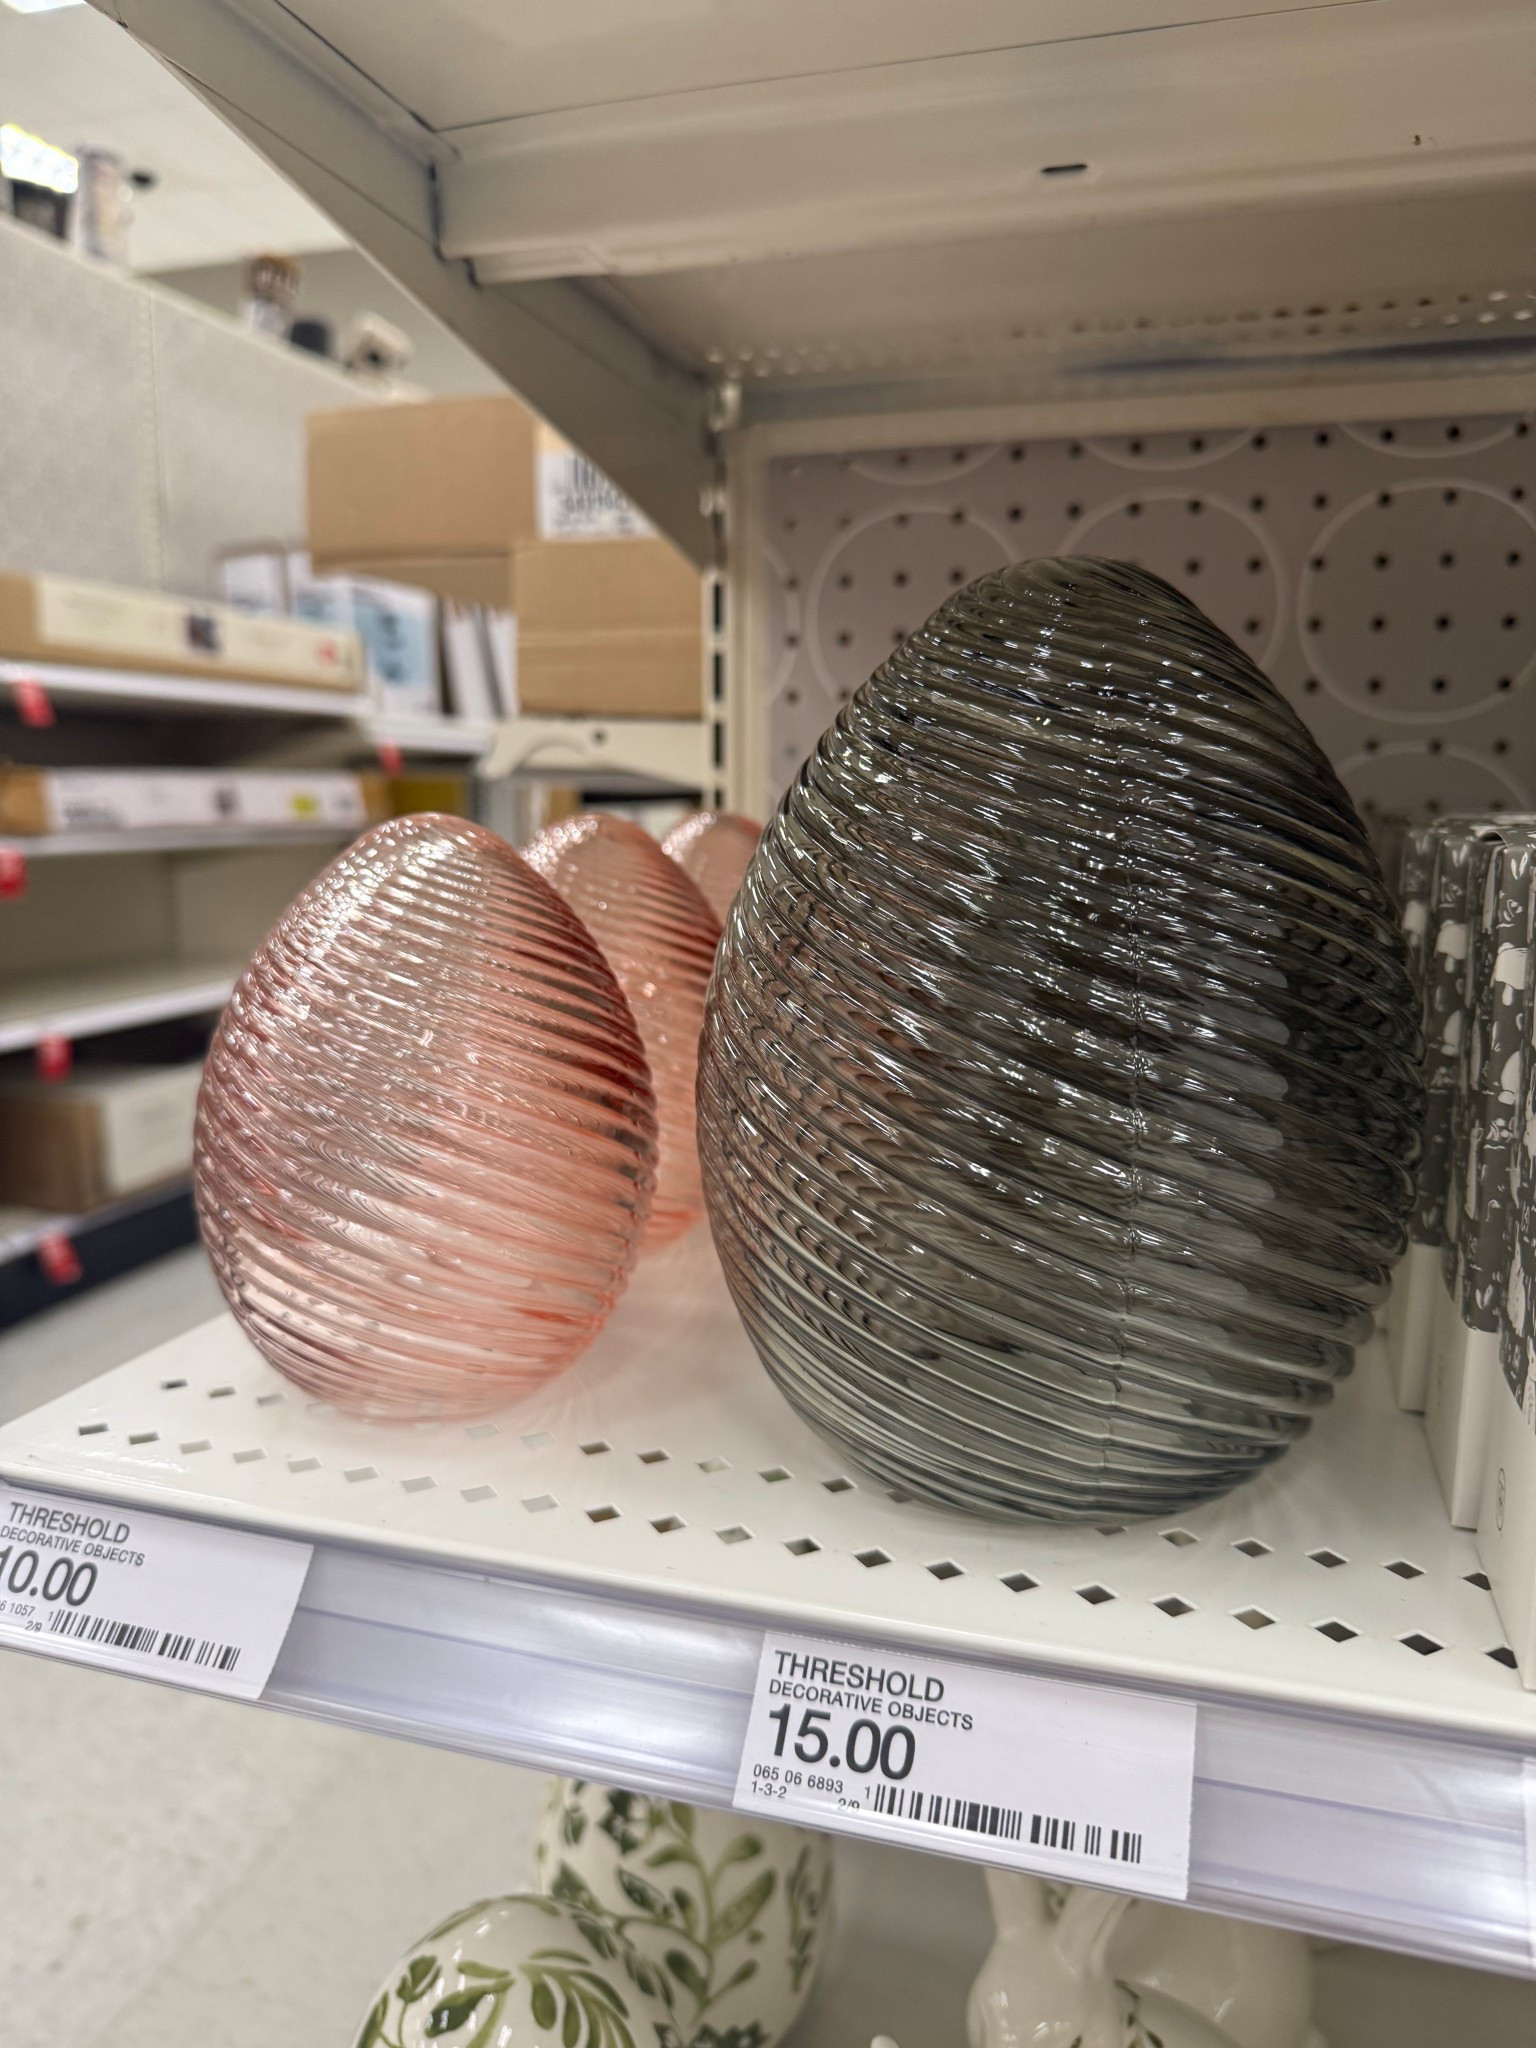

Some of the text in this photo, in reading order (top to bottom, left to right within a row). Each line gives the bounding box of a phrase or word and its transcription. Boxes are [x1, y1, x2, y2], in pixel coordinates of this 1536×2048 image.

[10, 1502, 130, 1543] THRESHOLD
[0, 1525, 146, 1567] DECORATIVE OBJECTS
[0, 1545, 98, 1606] 10.00
[10, 1602, 36, 1617] 1057
[25, 1620, 43, 1632] 2/9
[775, 1650, 944, 1702] THRESHOLD
[769, 1679, 973, 1730] DECORATIVE OBJECTS
[768, 1703, 916, 1780] 15.00
[751, 1780, 788, 1798] 1-3-2
[753, 1764, 843, 1793] 065 06 6893
